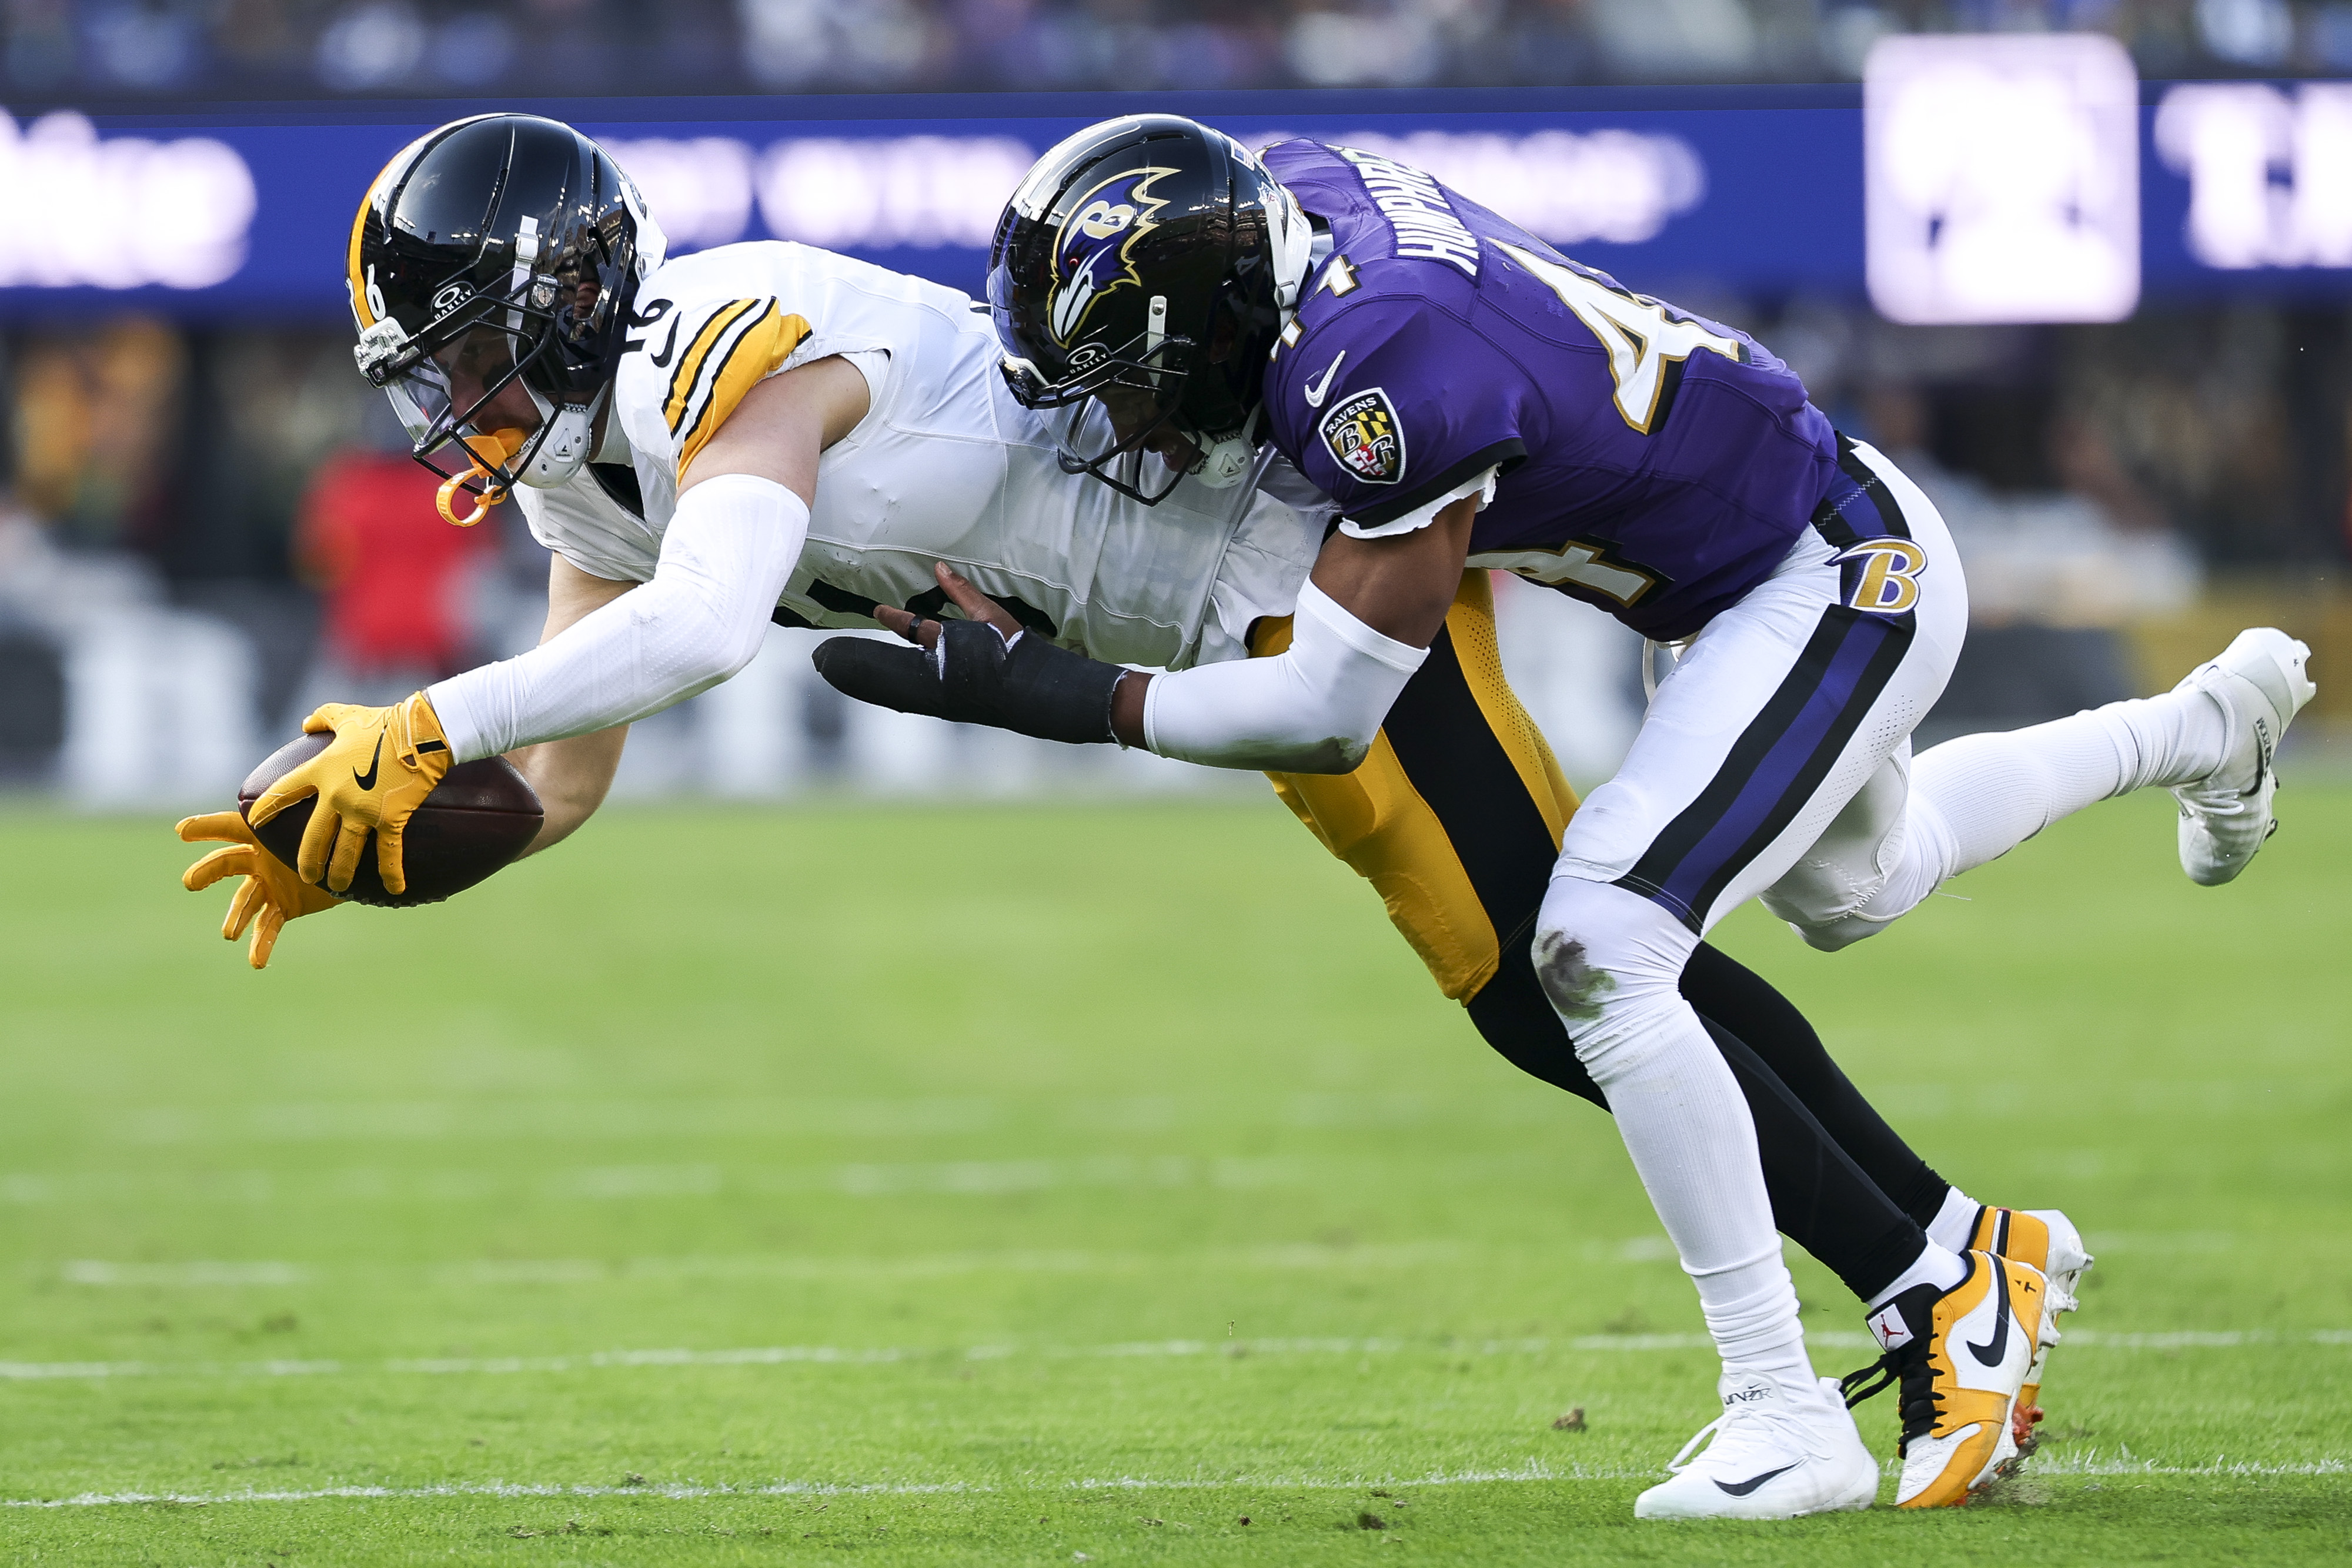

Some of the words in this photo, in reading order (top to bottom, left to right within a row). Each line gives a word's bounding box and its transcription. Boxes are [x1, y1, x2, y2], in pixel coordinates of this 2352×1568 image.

[1325, 144, 1481, 276] HUMPHR
[434, 289, 472, 320] OAKLEY
[1485, 236, 1740, 436] 4
[1070, 353, 1107, 374] OAKLEY
[1325, 397, 1377, 434] RAVENS
[1332, 420, 1362, 455] B
[1831, 537, 1928, 614] B
